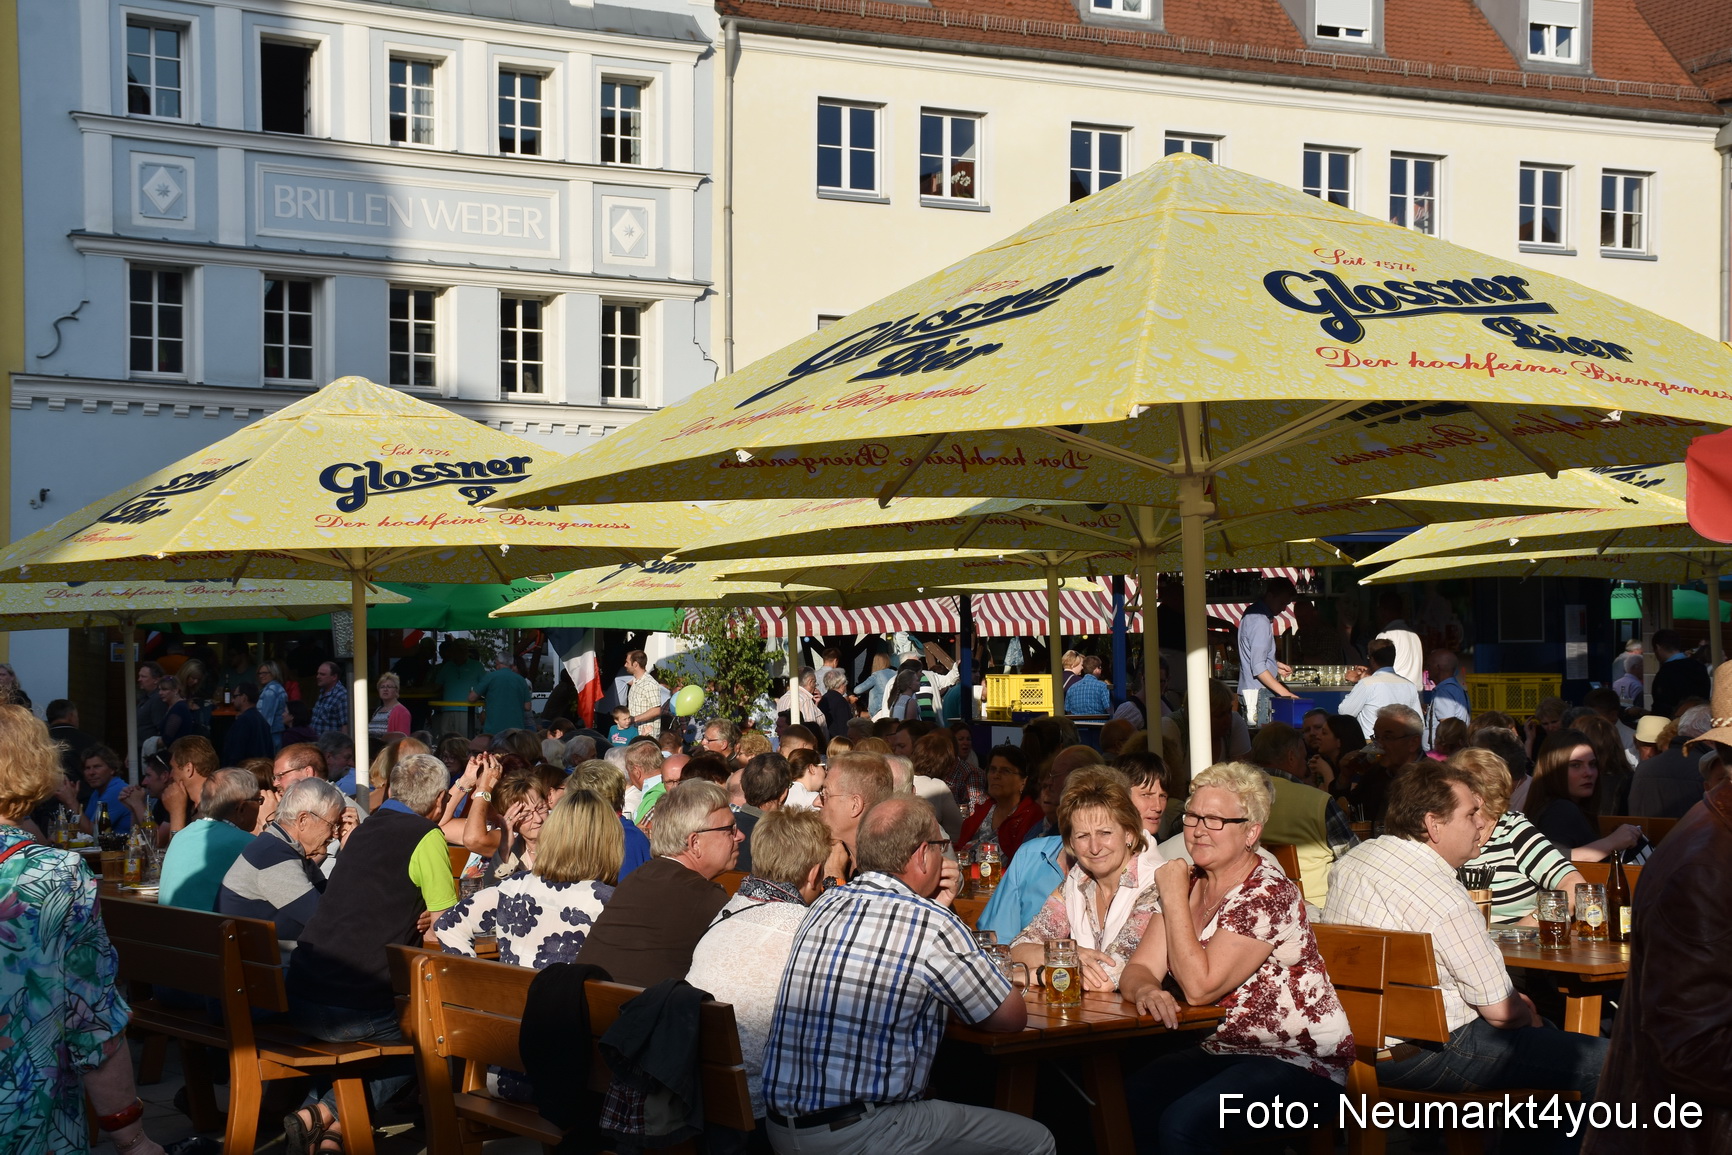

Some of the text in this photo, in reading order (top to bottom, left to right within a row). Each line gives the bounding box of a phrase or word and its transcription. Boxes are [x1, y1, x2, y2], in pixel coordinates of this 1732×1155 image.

[274, 184, 545, 240] BRILLEN WEBER
[1313, 248, 1418, 272] Seit 1574
[1263, 269, 1558, 344] Glossner
[1481, 316, 1634, 363] Bier
[1316, 346, 1732, 400] Der hochfeine Biergenus
[380, 443, 414, 457] Seit
[319, 456, 533, 513] Glossner
[314, 513, 631, 531] Der hochfeine Biergenuss
[184, 585, 286, 596] Biergenuss
